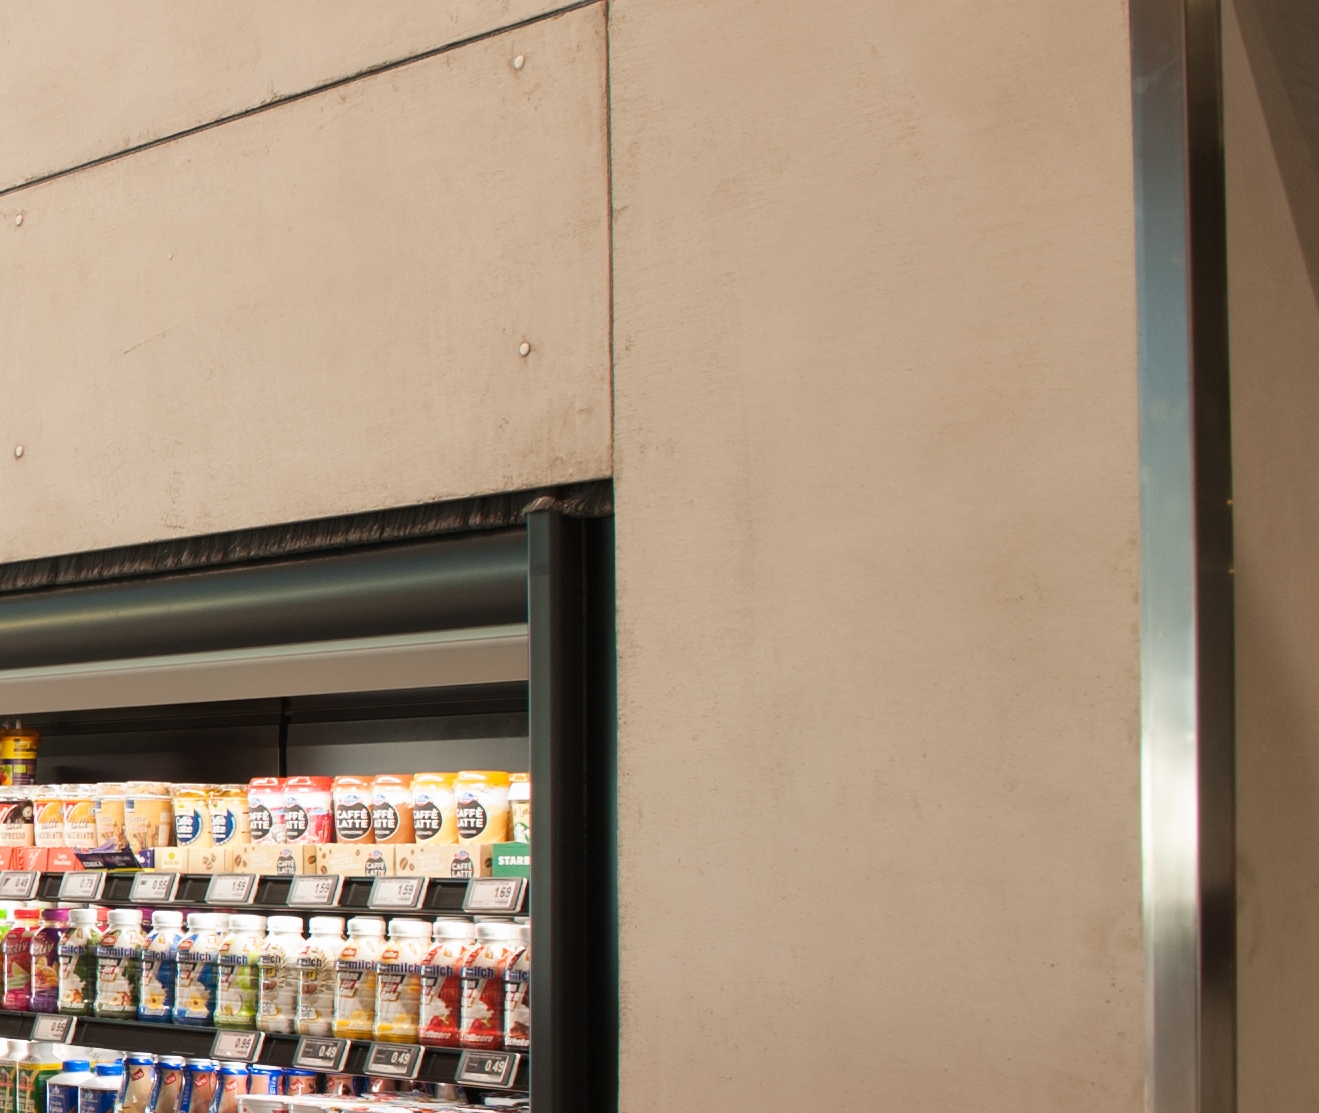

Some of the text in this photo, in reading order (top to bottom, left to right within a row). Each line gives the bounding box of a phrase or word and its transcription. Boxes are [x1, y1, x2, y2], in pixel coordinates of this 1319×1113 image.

[335, 806, 372, 821] CAFFÈ
[336, 818, 369, 830] LATTE
[231, 881, 247, 893] 1.59
[314, 883, 330, 894] 1.59
[397, 884, 414, 896] 1.59
[318, 1045, 336, 1058] 0.49
[390, 1051, 410, 1065] 0.49
[484, 1060, 505, 1073] 0.49
